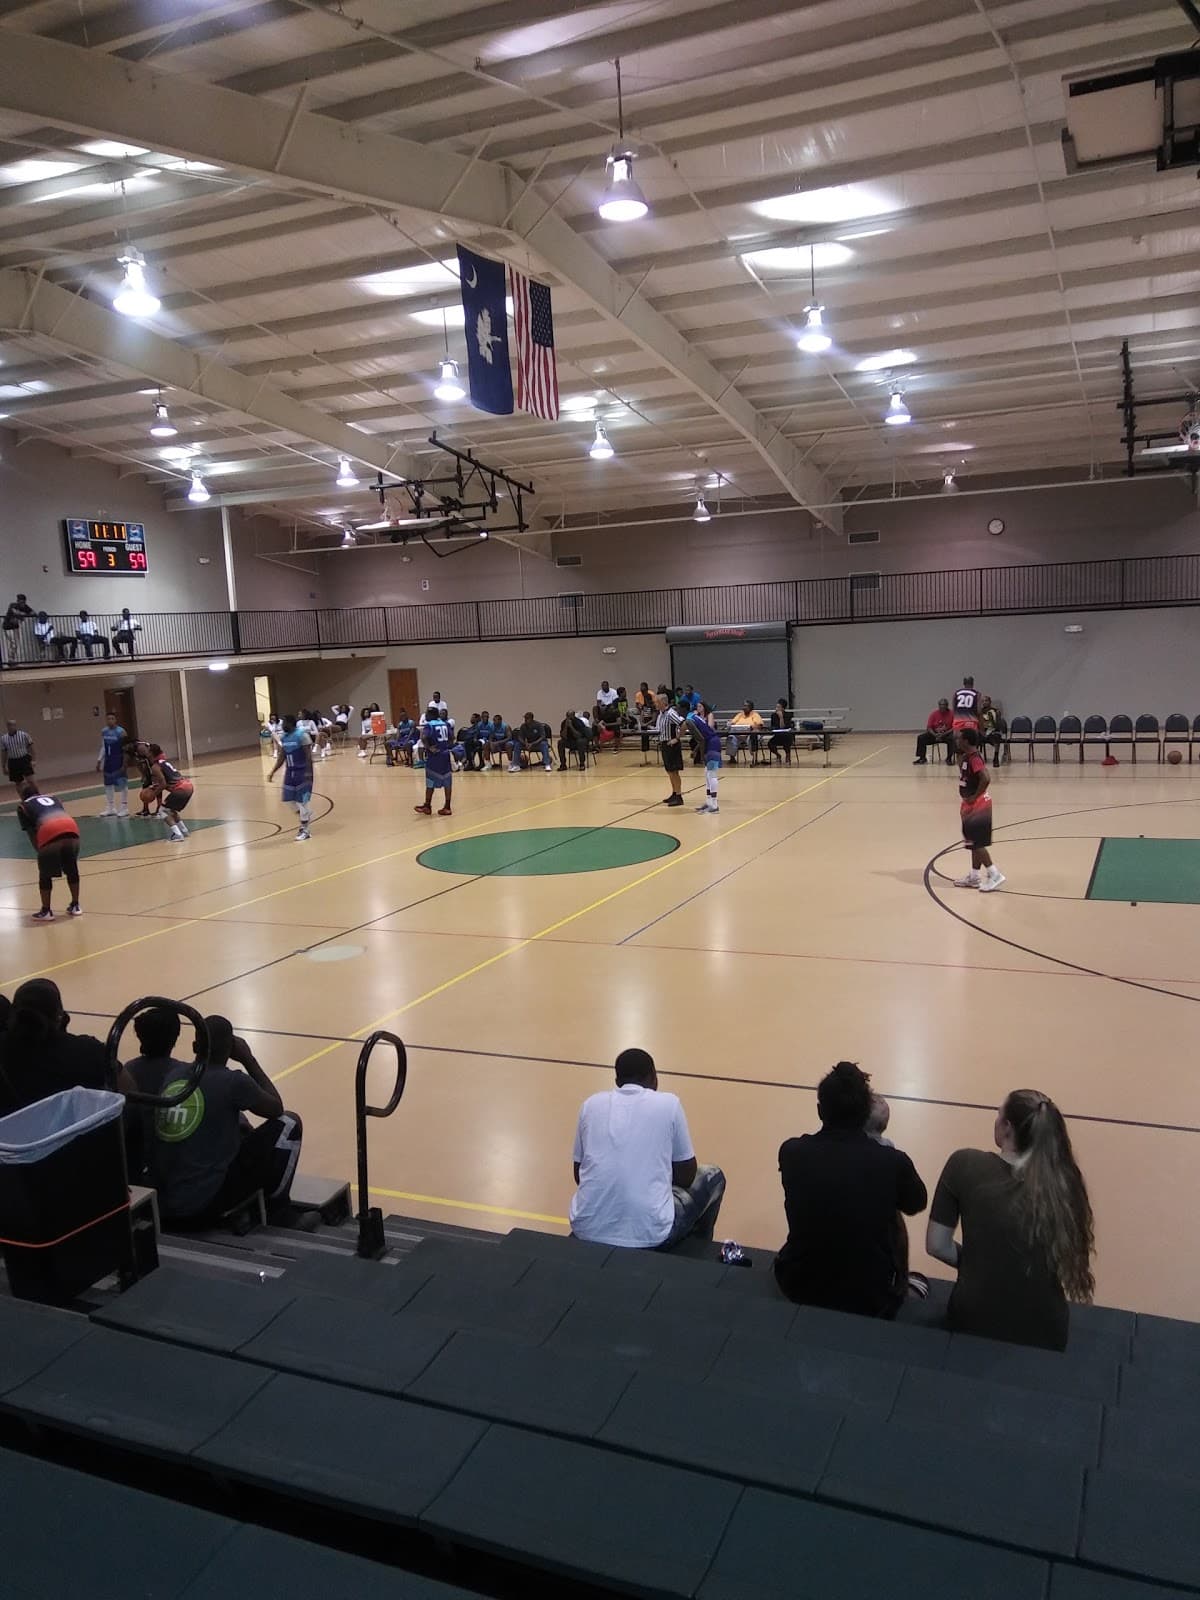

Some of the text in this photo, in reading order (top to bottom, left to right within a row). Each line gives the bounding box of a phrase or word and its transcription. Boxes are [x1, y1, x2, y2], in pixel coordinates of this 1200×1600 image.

[74, 541, 92, 549] HOME
[125, 543, 143, 551] GUEST
[78, 551, 97, 568] 59
[108, 553, 116, 567] 3
[129, 552, 146, 569] 59
[957, 694, 974, 708] 20
[435, 725, 449, 742] 30
[36, 796, 55, 806] 0
